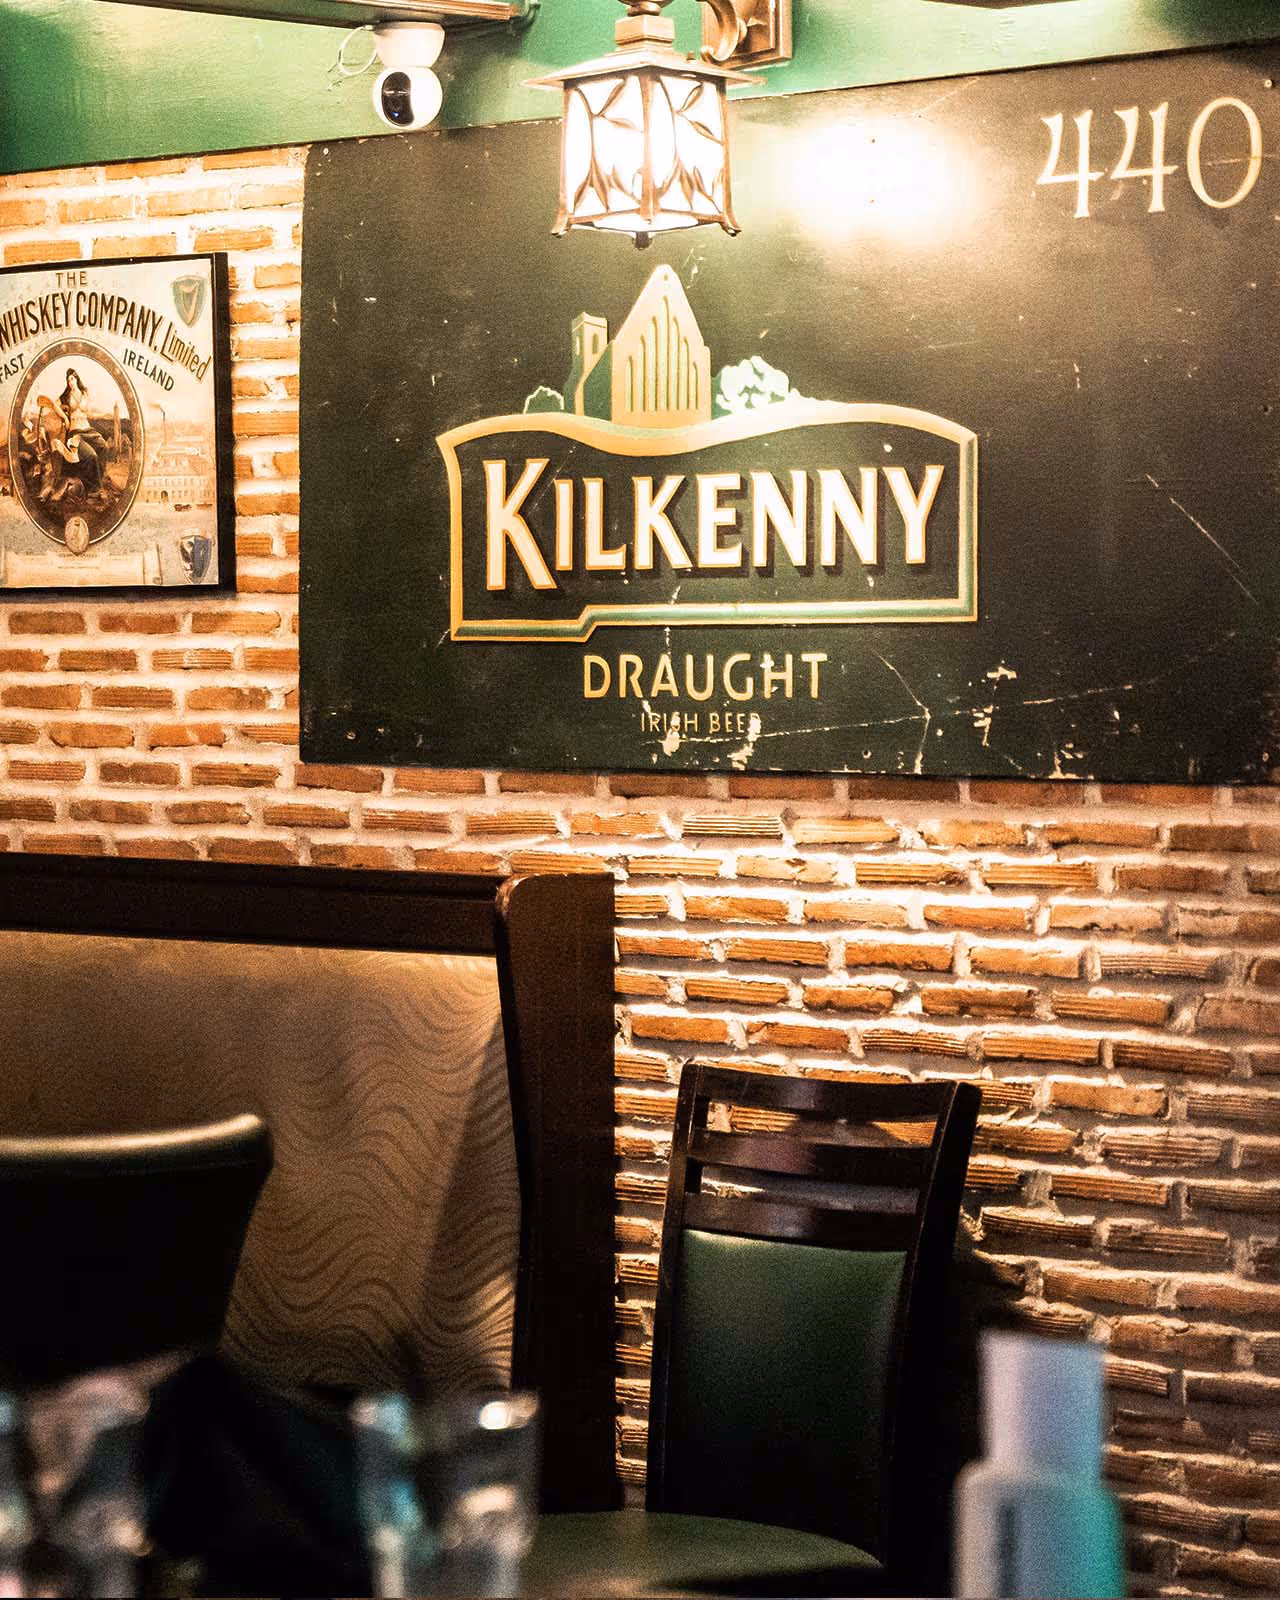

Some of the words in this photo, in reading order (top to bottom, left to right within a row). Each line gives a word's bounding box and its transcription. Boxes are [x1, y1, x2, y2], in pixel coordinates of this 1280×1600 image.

[1036, 97, 1262, 218] 440
[56, 271, 88, 289] THE
[123, 348, 175, 392] IRELAND
[160, 321, 212, 381] Limited
[483, 457, 945, 591] KILKENNY
[583, 653, 828, 701] DRAUGHT
[640, 711, 698, 733] IRISH
